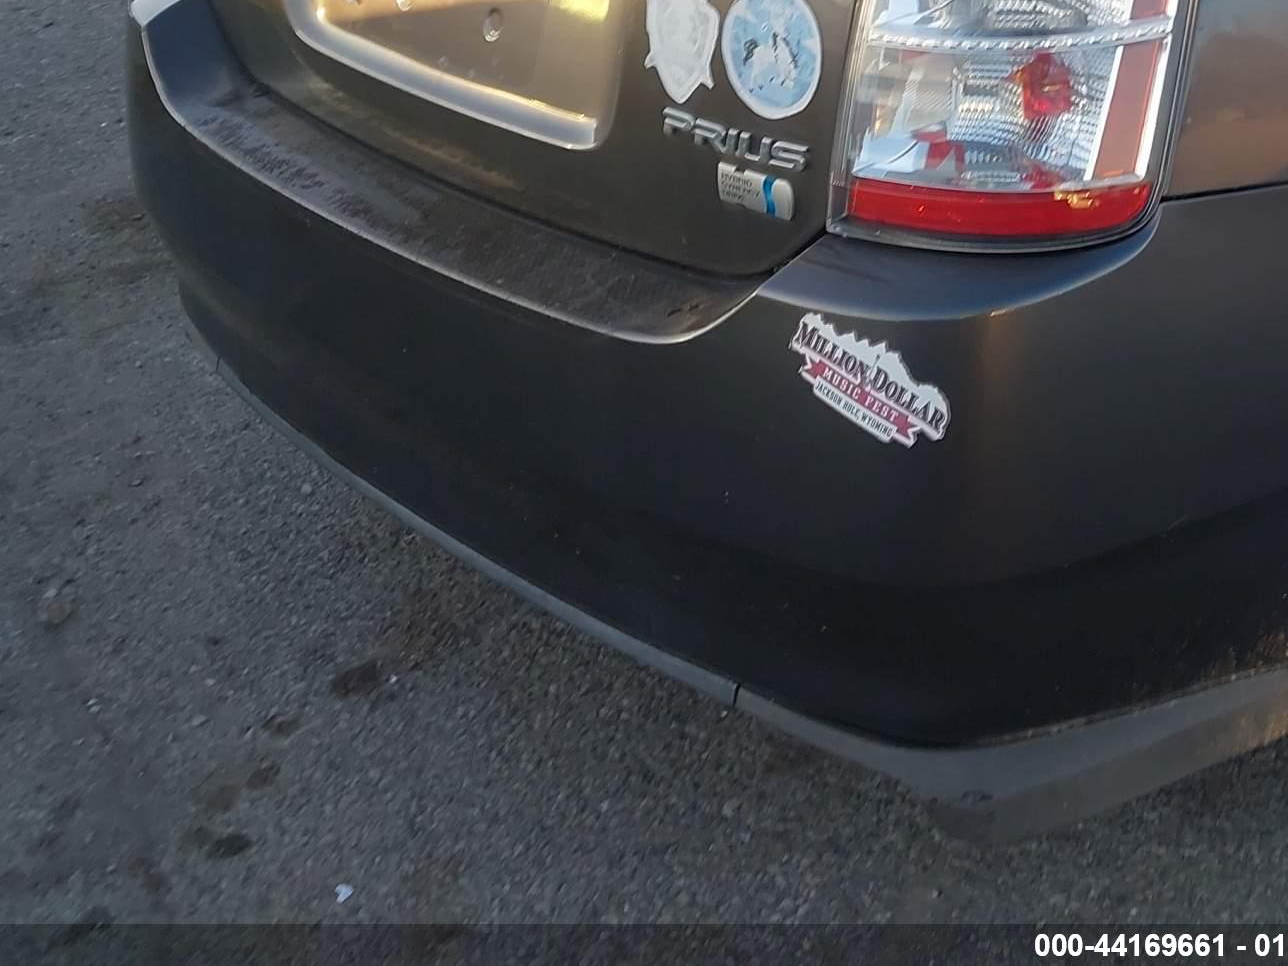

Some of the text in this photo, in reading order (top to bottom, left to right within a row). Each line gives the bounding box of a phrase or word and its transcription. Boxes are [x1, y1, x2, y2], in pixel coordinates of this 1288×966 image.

[663, 107, 809, 171] PRIUS
[795, 323, 946, 430] MILLION DOLLAR
[822, 366, 899, 421] MUSIC FEST
[815, 381, 843, 409] JACKSON
[860, 411, 893, 438] WYOMING
